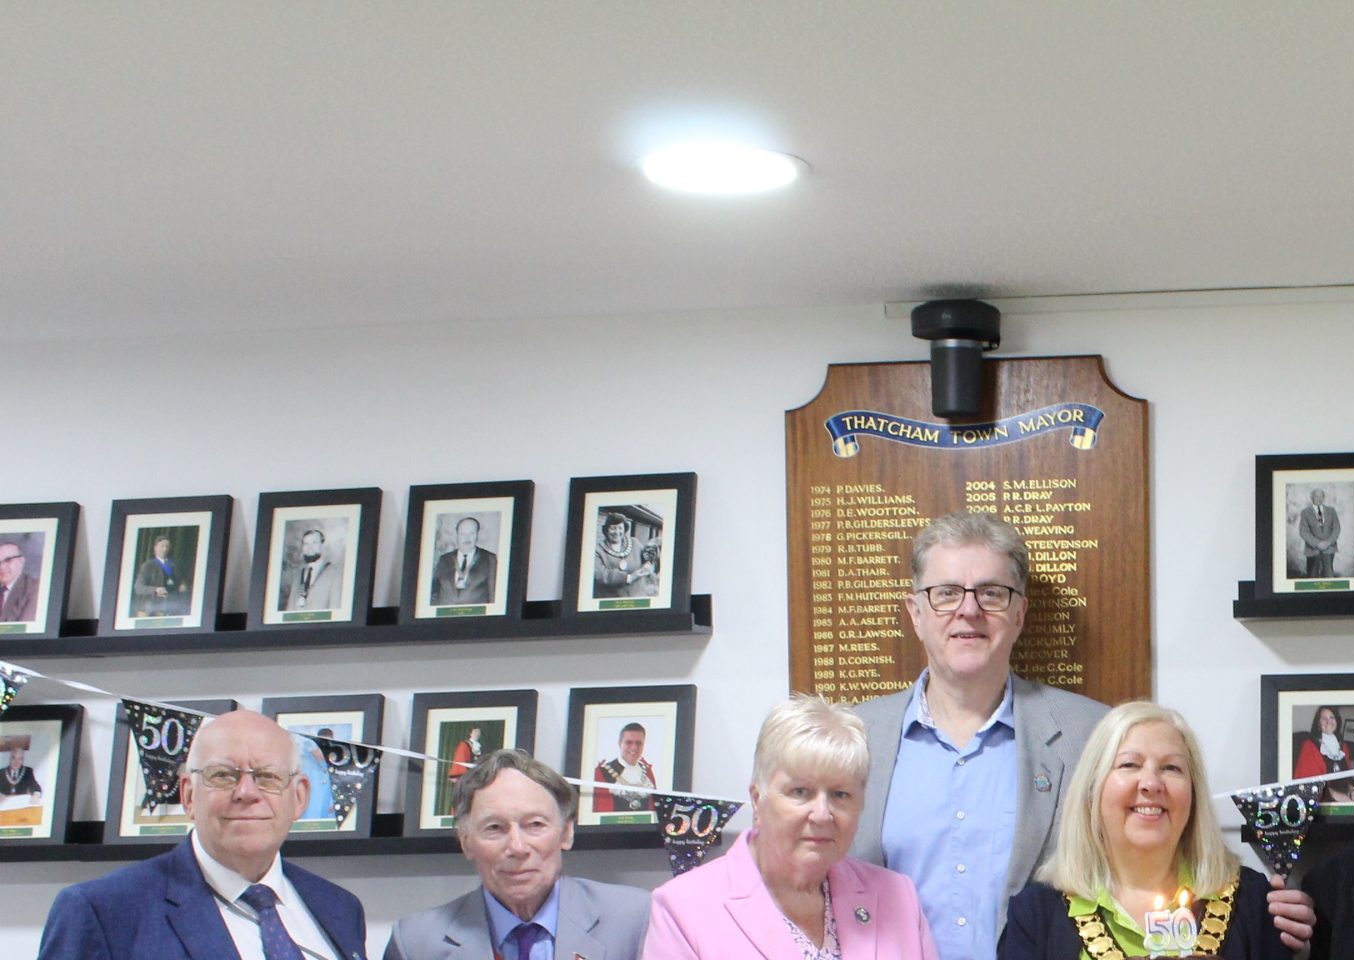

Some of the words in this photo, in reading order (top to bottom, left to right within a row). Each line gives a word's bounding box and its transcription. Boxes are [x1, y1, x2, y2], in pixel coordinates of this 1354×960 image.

[842, 415, 940, 444] THATCHAM
[950, 425, 1009, 445] TOWN
[1018, 408, 1085, 434] MAYOR
[810, 486, 831, 495] 1974
[966, 481, 996, 491] 2004
[811, 498, 831, 506] 1975
[966, 493, 996, 502] 2005
[811, 510, 831, 518] 1976
[966, 505, 997, 514] 2006
[811, 521, 831, 530] 1977
[812, 533, 832, 541] 1978
[1025, 539, 1098, 549] STEEVENSON
[812, 545, 832, 553] 1979
[812, 557, 832, 565] 1980
[812, 569, 830, 577] 1981
[813, 581, 832, 590] 1982
[813, 594, 832, 602] 1983
[813, 619, 832, 627] 1985
[814, 631, 833, 640] 1986
[814, 645, 834, 653] 1987
[814, 658, 834, 666] 1988
[814, 670, 835, 679] 1989
[815, 683, 836, 692] 1990
[139, 712, 185, 756] 50
[1255, 794, 1306, 829] 50
[665, 803, 719, 837] 50
[1144, 907, 1198, 950] 50
